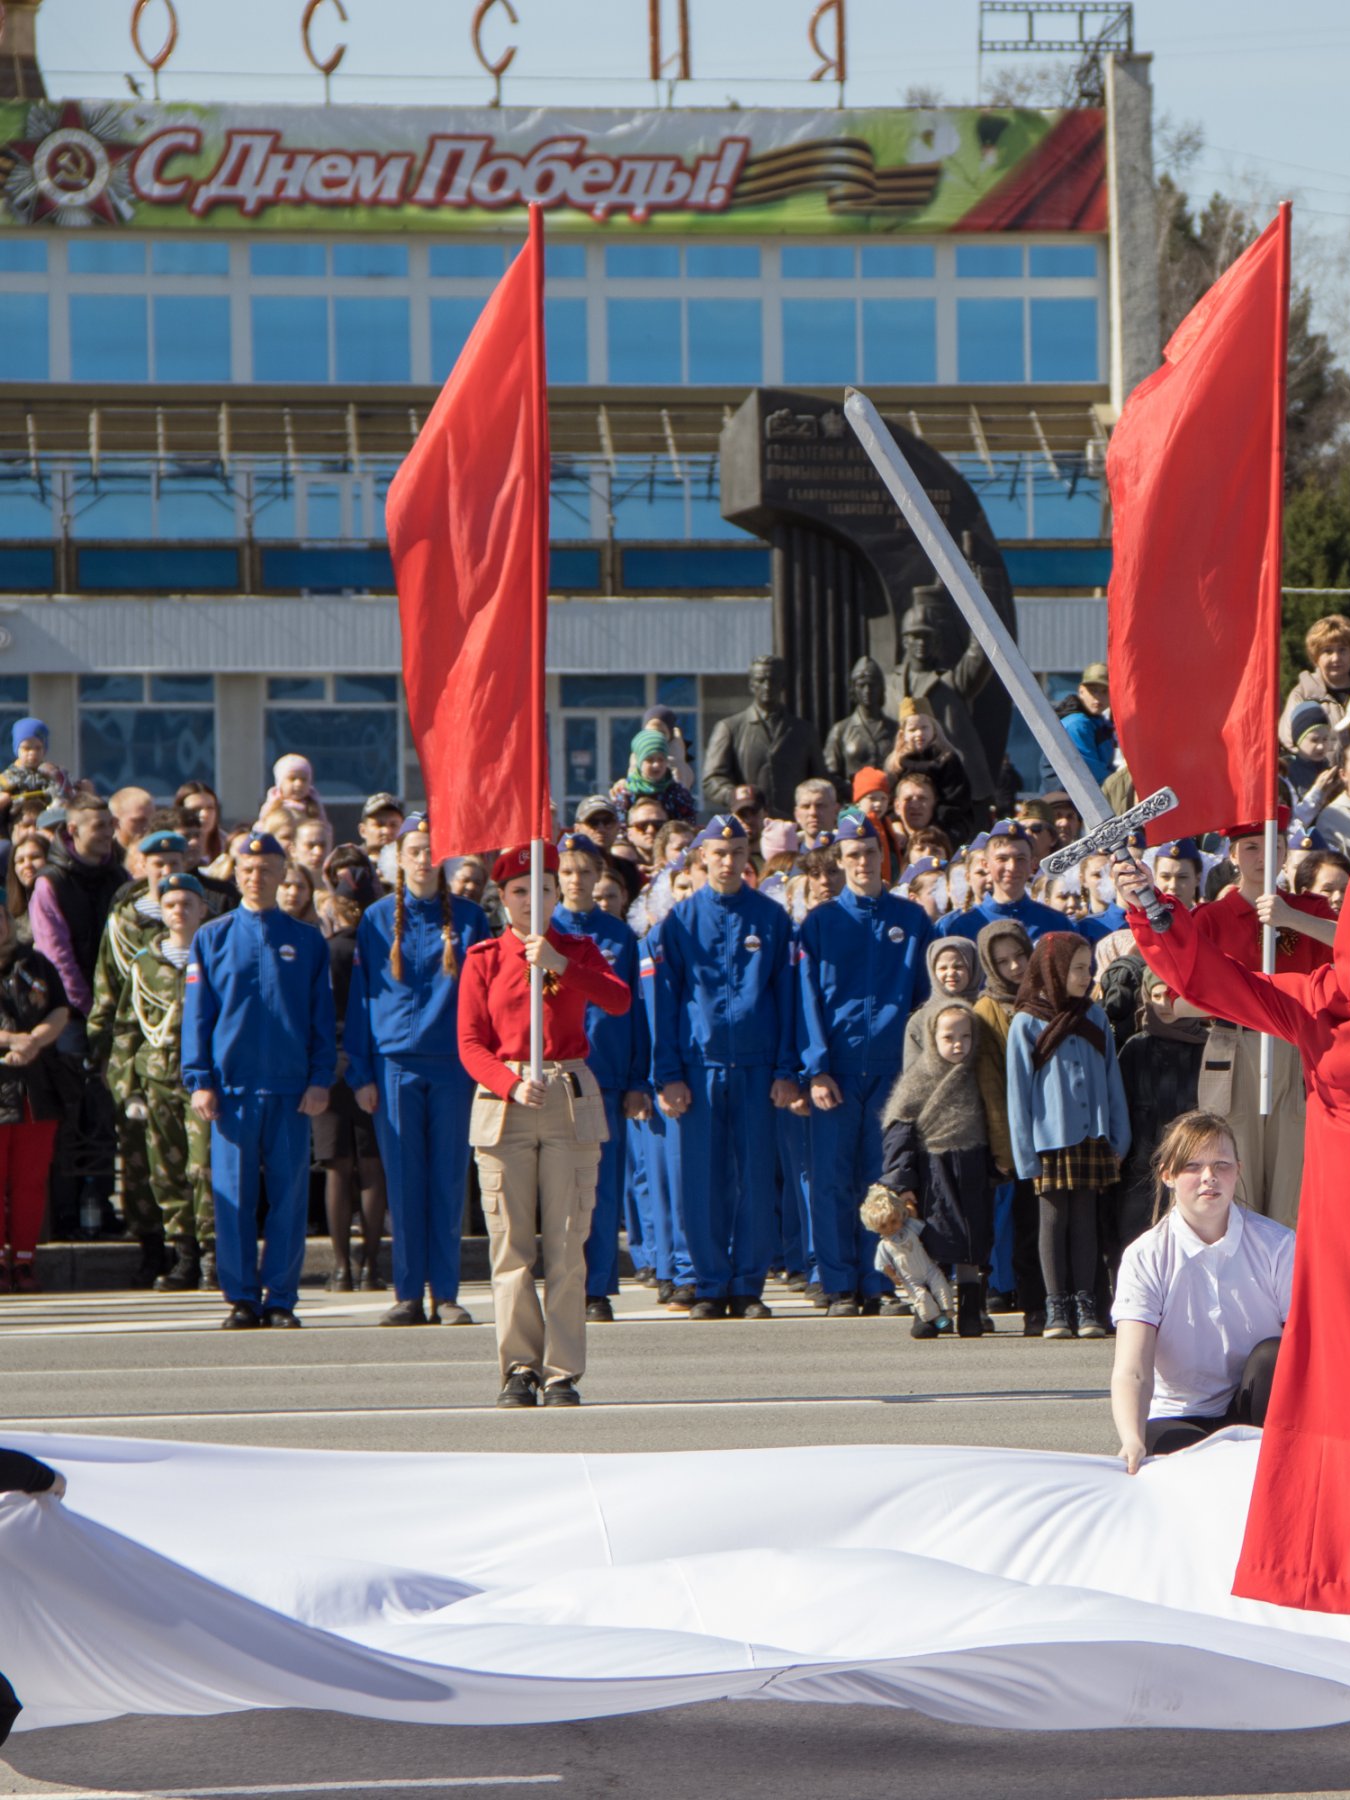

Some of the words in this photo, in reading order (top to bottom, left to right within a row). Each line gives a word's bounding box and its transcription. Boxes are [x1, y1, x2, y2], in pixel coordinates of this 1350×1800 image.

[131, 128, 202, 203] С
[190, 130, 411, 215] Днем
[407, 135, 752, 223] Победы!
